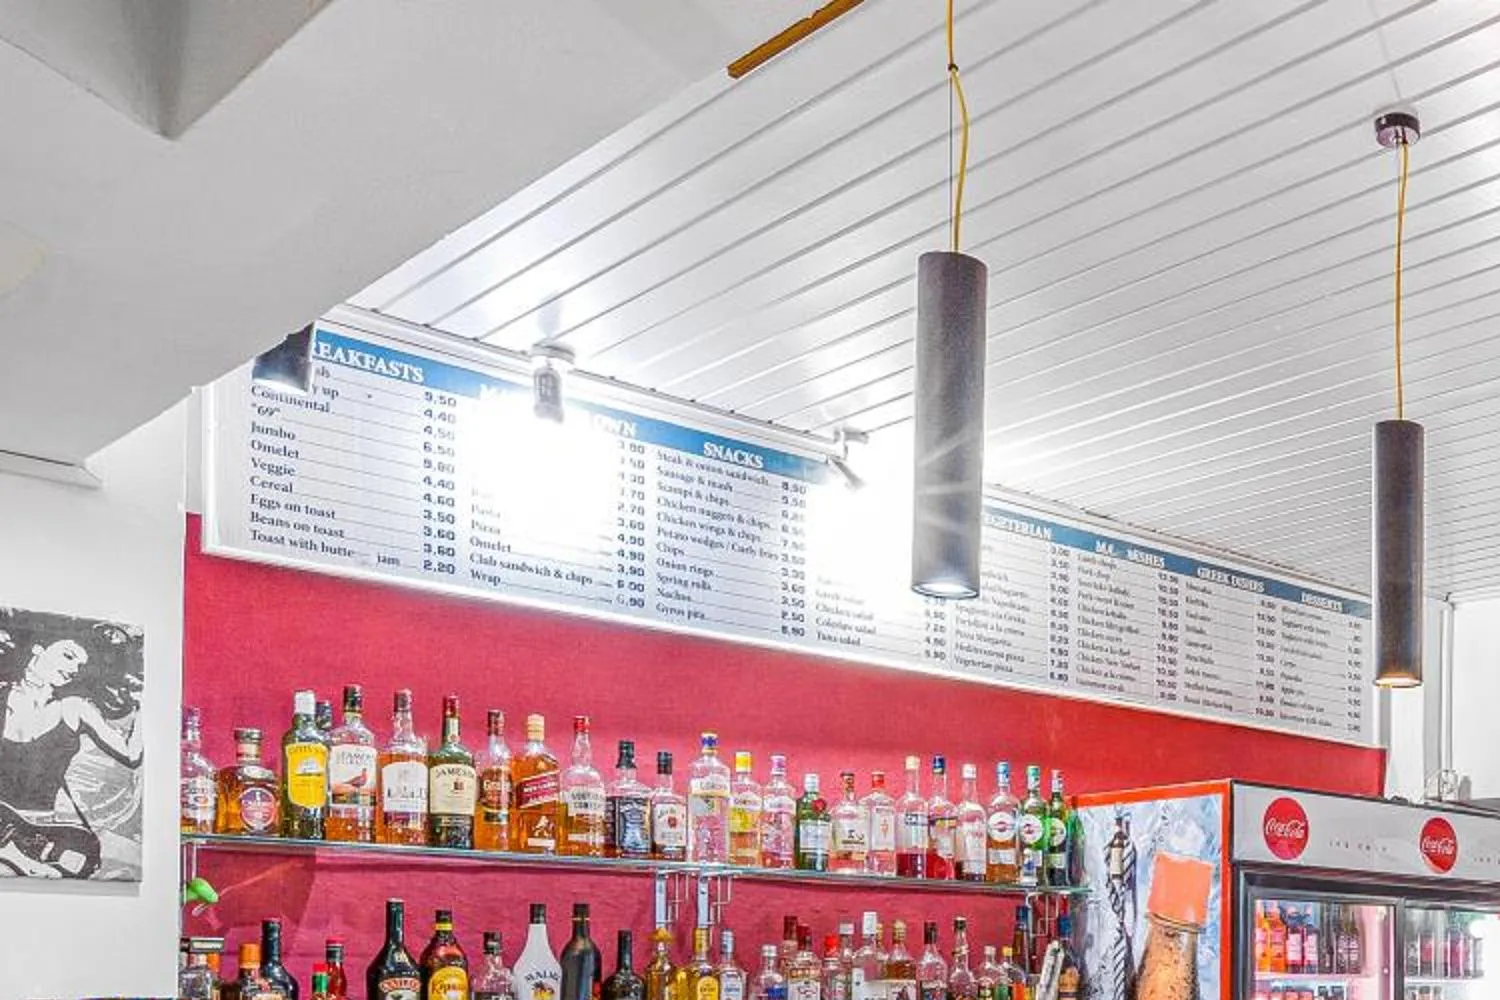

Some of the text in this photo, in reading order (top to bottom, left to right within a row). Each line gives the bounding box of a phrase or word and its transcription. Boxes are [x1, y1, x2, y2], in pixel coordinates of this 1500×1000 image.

[312, 338, 425, 383] EAKFASTS
[251, 421, 296, 440] Jumbo
[251, 440, 300, 459] Omelet
[703, 441, 765, 469] SNACKS
[251, 457, 296, 477] Veggie
[250, 475, 294, 493] Cereal
[251, 494, 281, 510] Eggs
[284, 501, 301, 513] on
[305, 504, 336, 519] toast
[657, 496, 697, 513] Chicken
[251, 511, 290, 529] Beans
[294, 520, 310, 532] on
[314, 522, 345, 538] toast
[657, 511, 697, 529] Chicken
[251, 529, 285, 545] Toast
[289, 535, 317, 551] with
[469, 536, 511, 553] Omelet
[470, 569, 501, 585] Wrap
[500, 560, 551, 577] sandwich
[1265, 817, 1306, 840] Coca-Cola
[1421, 835, 1456, 856] Coca-Cola
